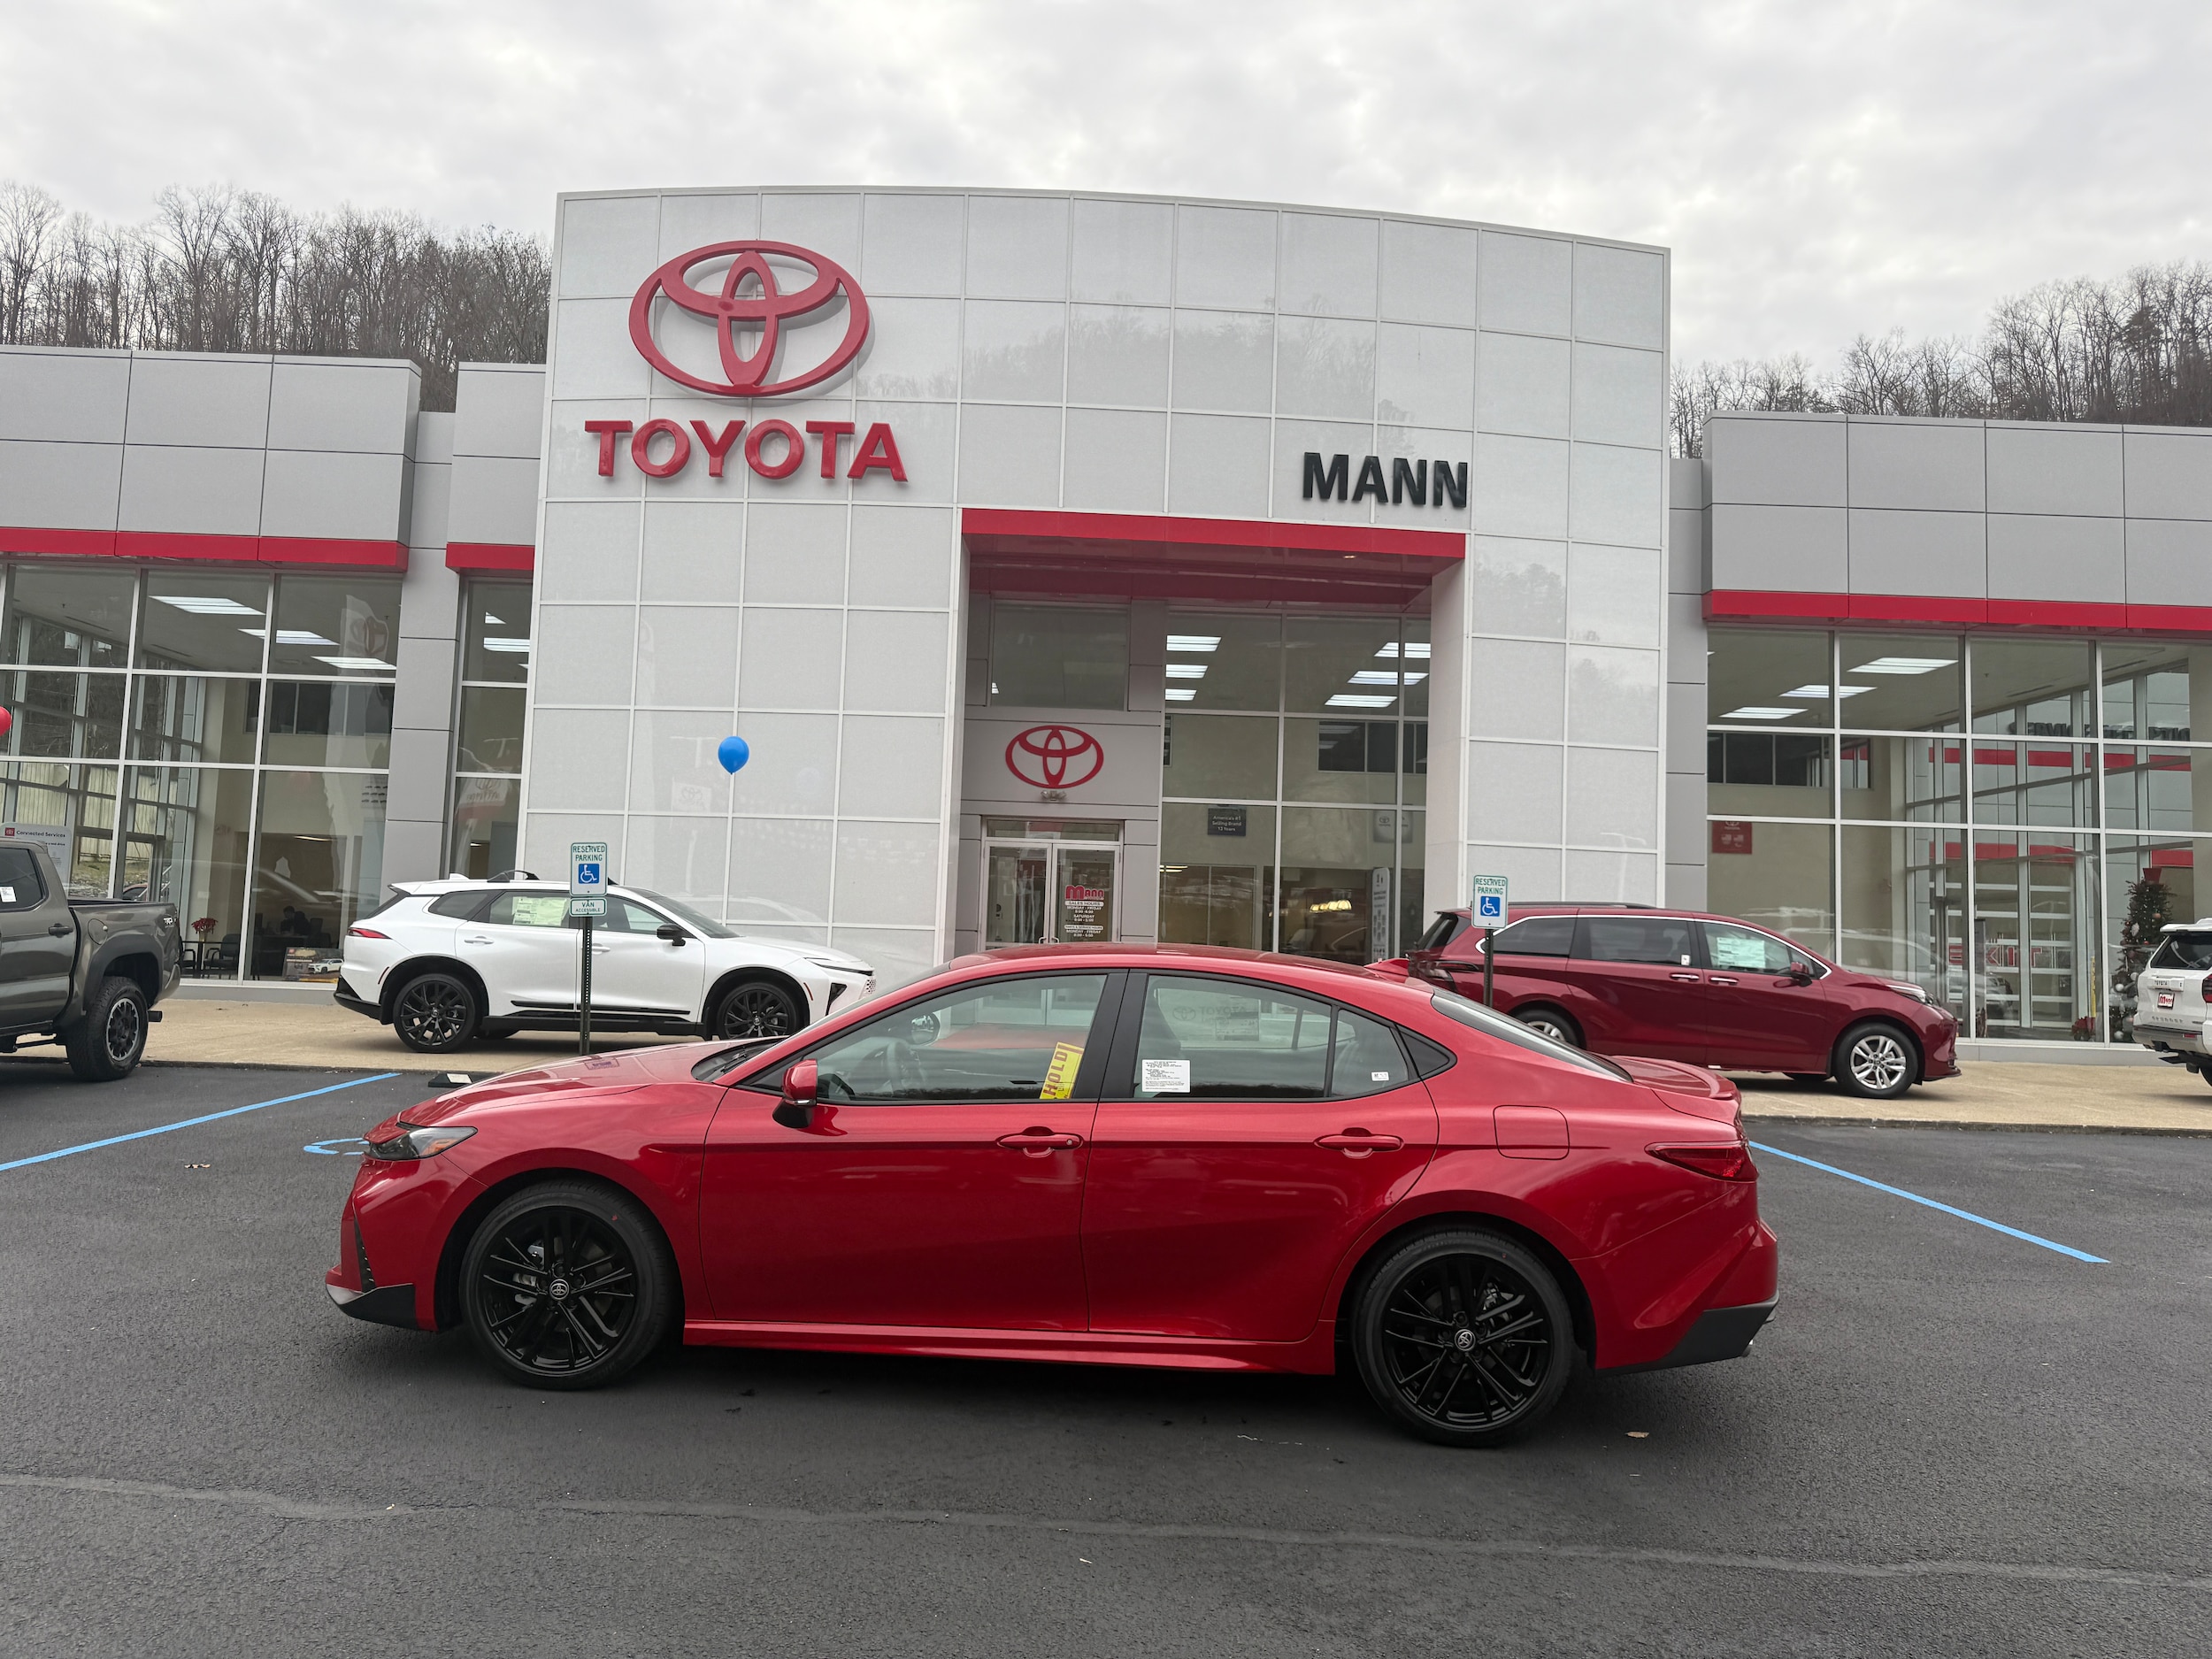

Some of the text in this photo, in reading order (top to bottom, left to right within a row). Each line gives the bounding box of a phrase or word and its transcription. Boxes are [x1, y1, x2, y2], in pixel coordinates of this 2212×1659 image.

[584, 418, 909, 482] TOYOTA
[1302, 451, 1468, 508] MANN
[1475, 878, 1506, 887] RESERVED
[1042, 1050, 1068, 1096] HOLD
